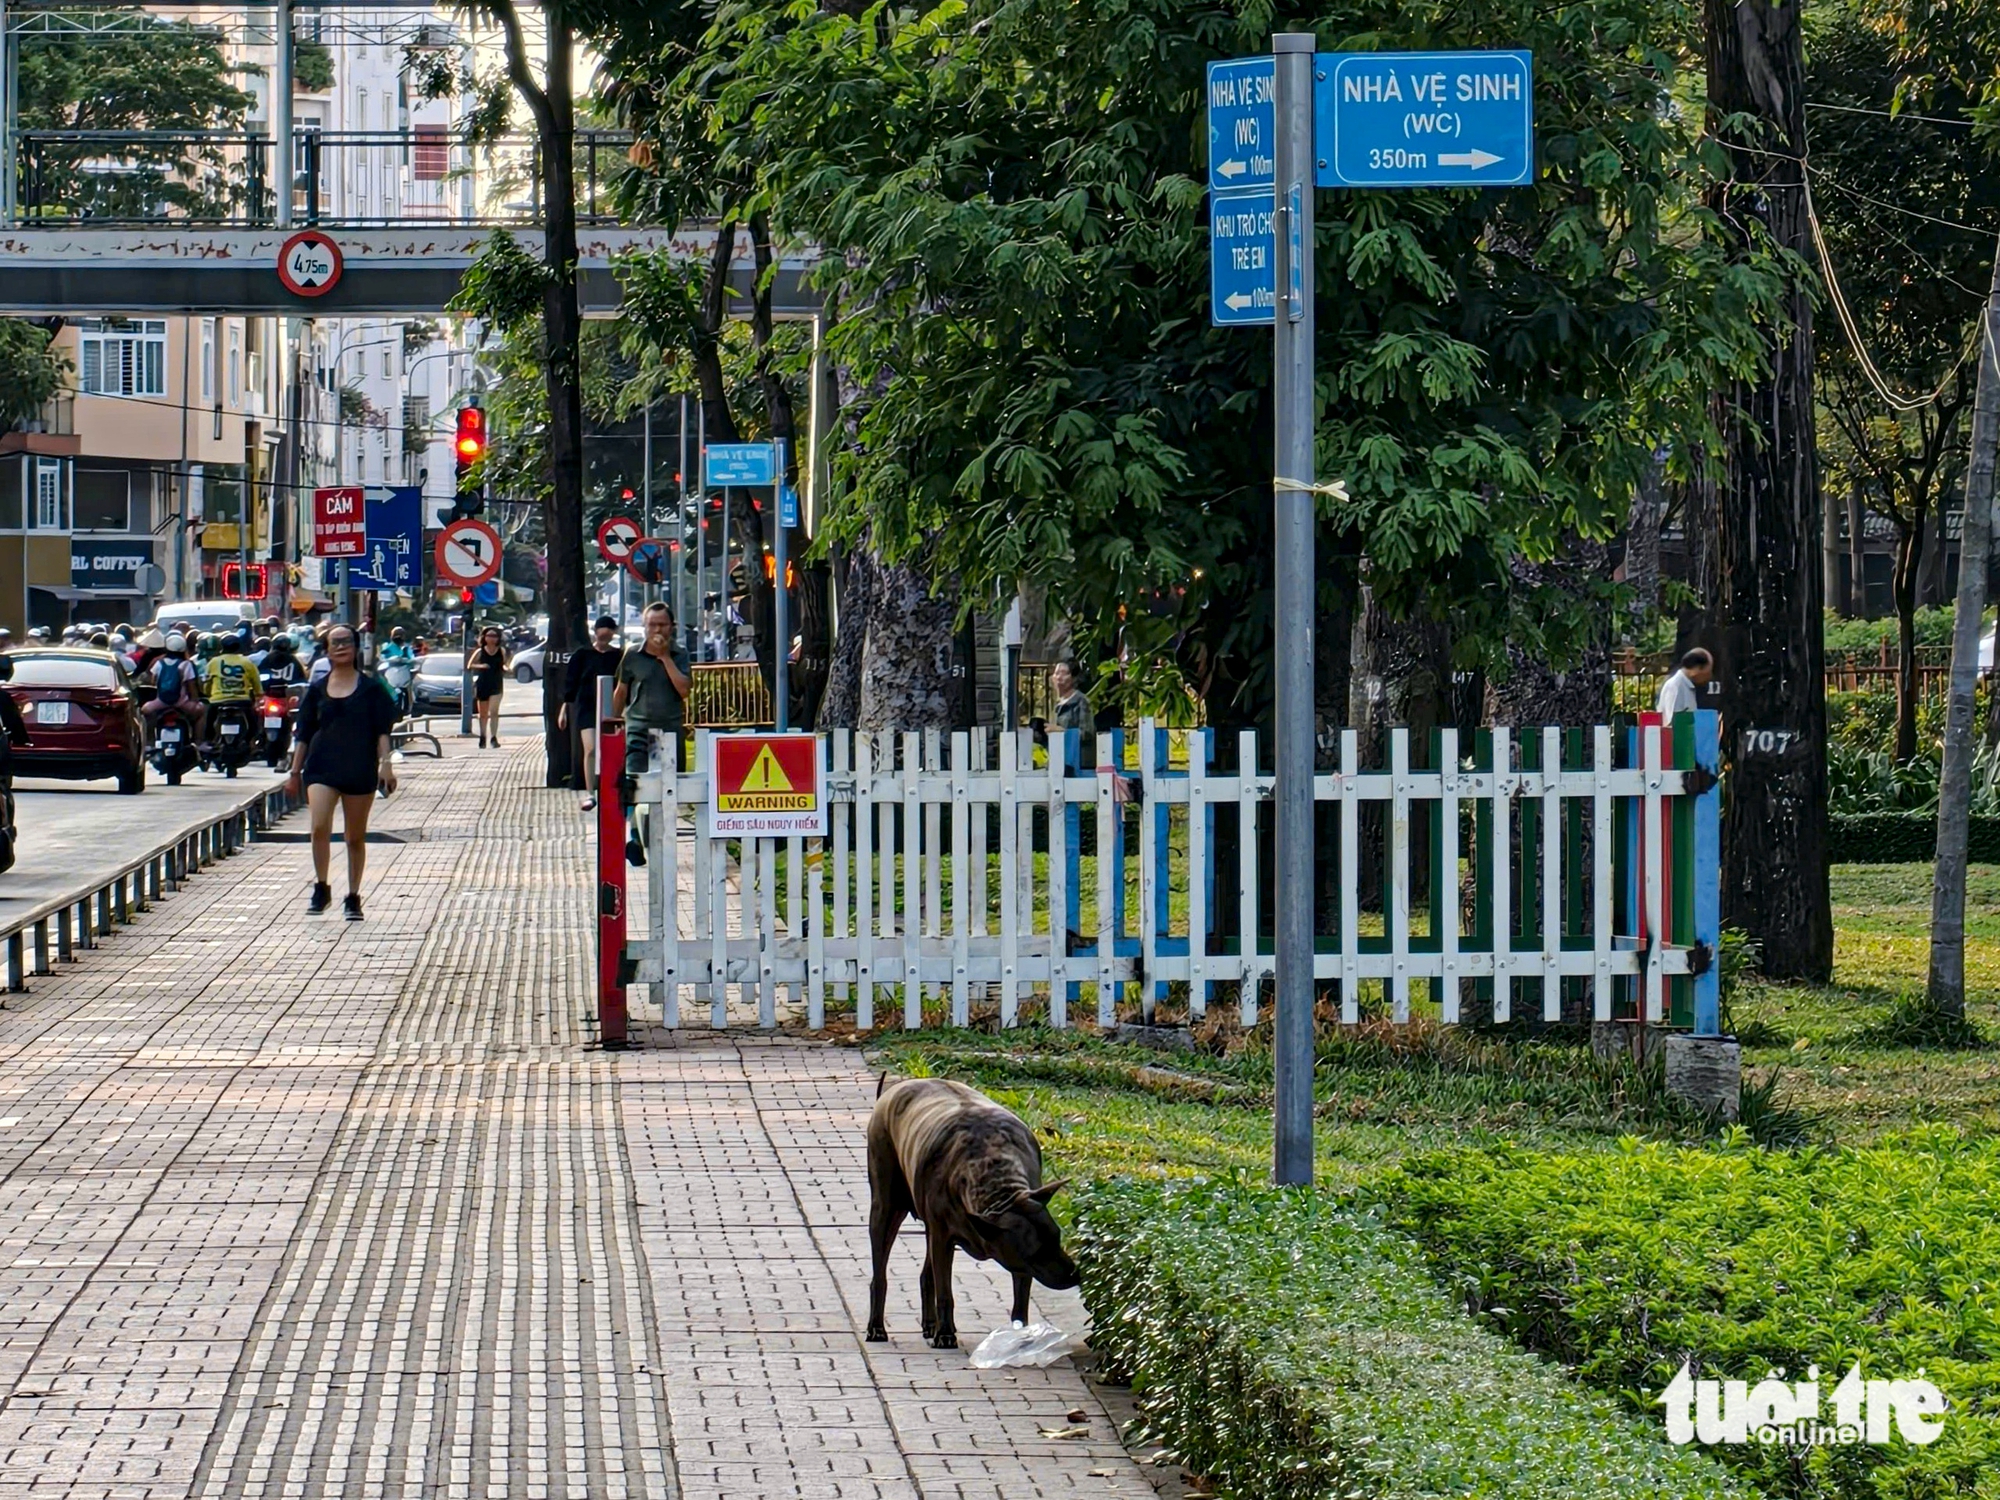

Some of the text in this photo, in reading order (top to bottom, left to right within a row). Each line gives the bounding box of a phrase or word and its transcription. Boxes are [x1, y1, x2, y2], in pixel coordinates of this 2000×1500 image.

[1344, 68, 1520, 108] NHÀ VỆ SINH
[1234, 117, 1260, 154] (WC)
[1403, 112, 1461, 139] (WC)
[1368, 148, 1427, 169] 350m
[1215, 215, 1235, 238] KHU
[1251, 245, 1266, 270] EM
[1746, 729, 1792, 755] 707
[727, 796, 808, 809] WARNING
